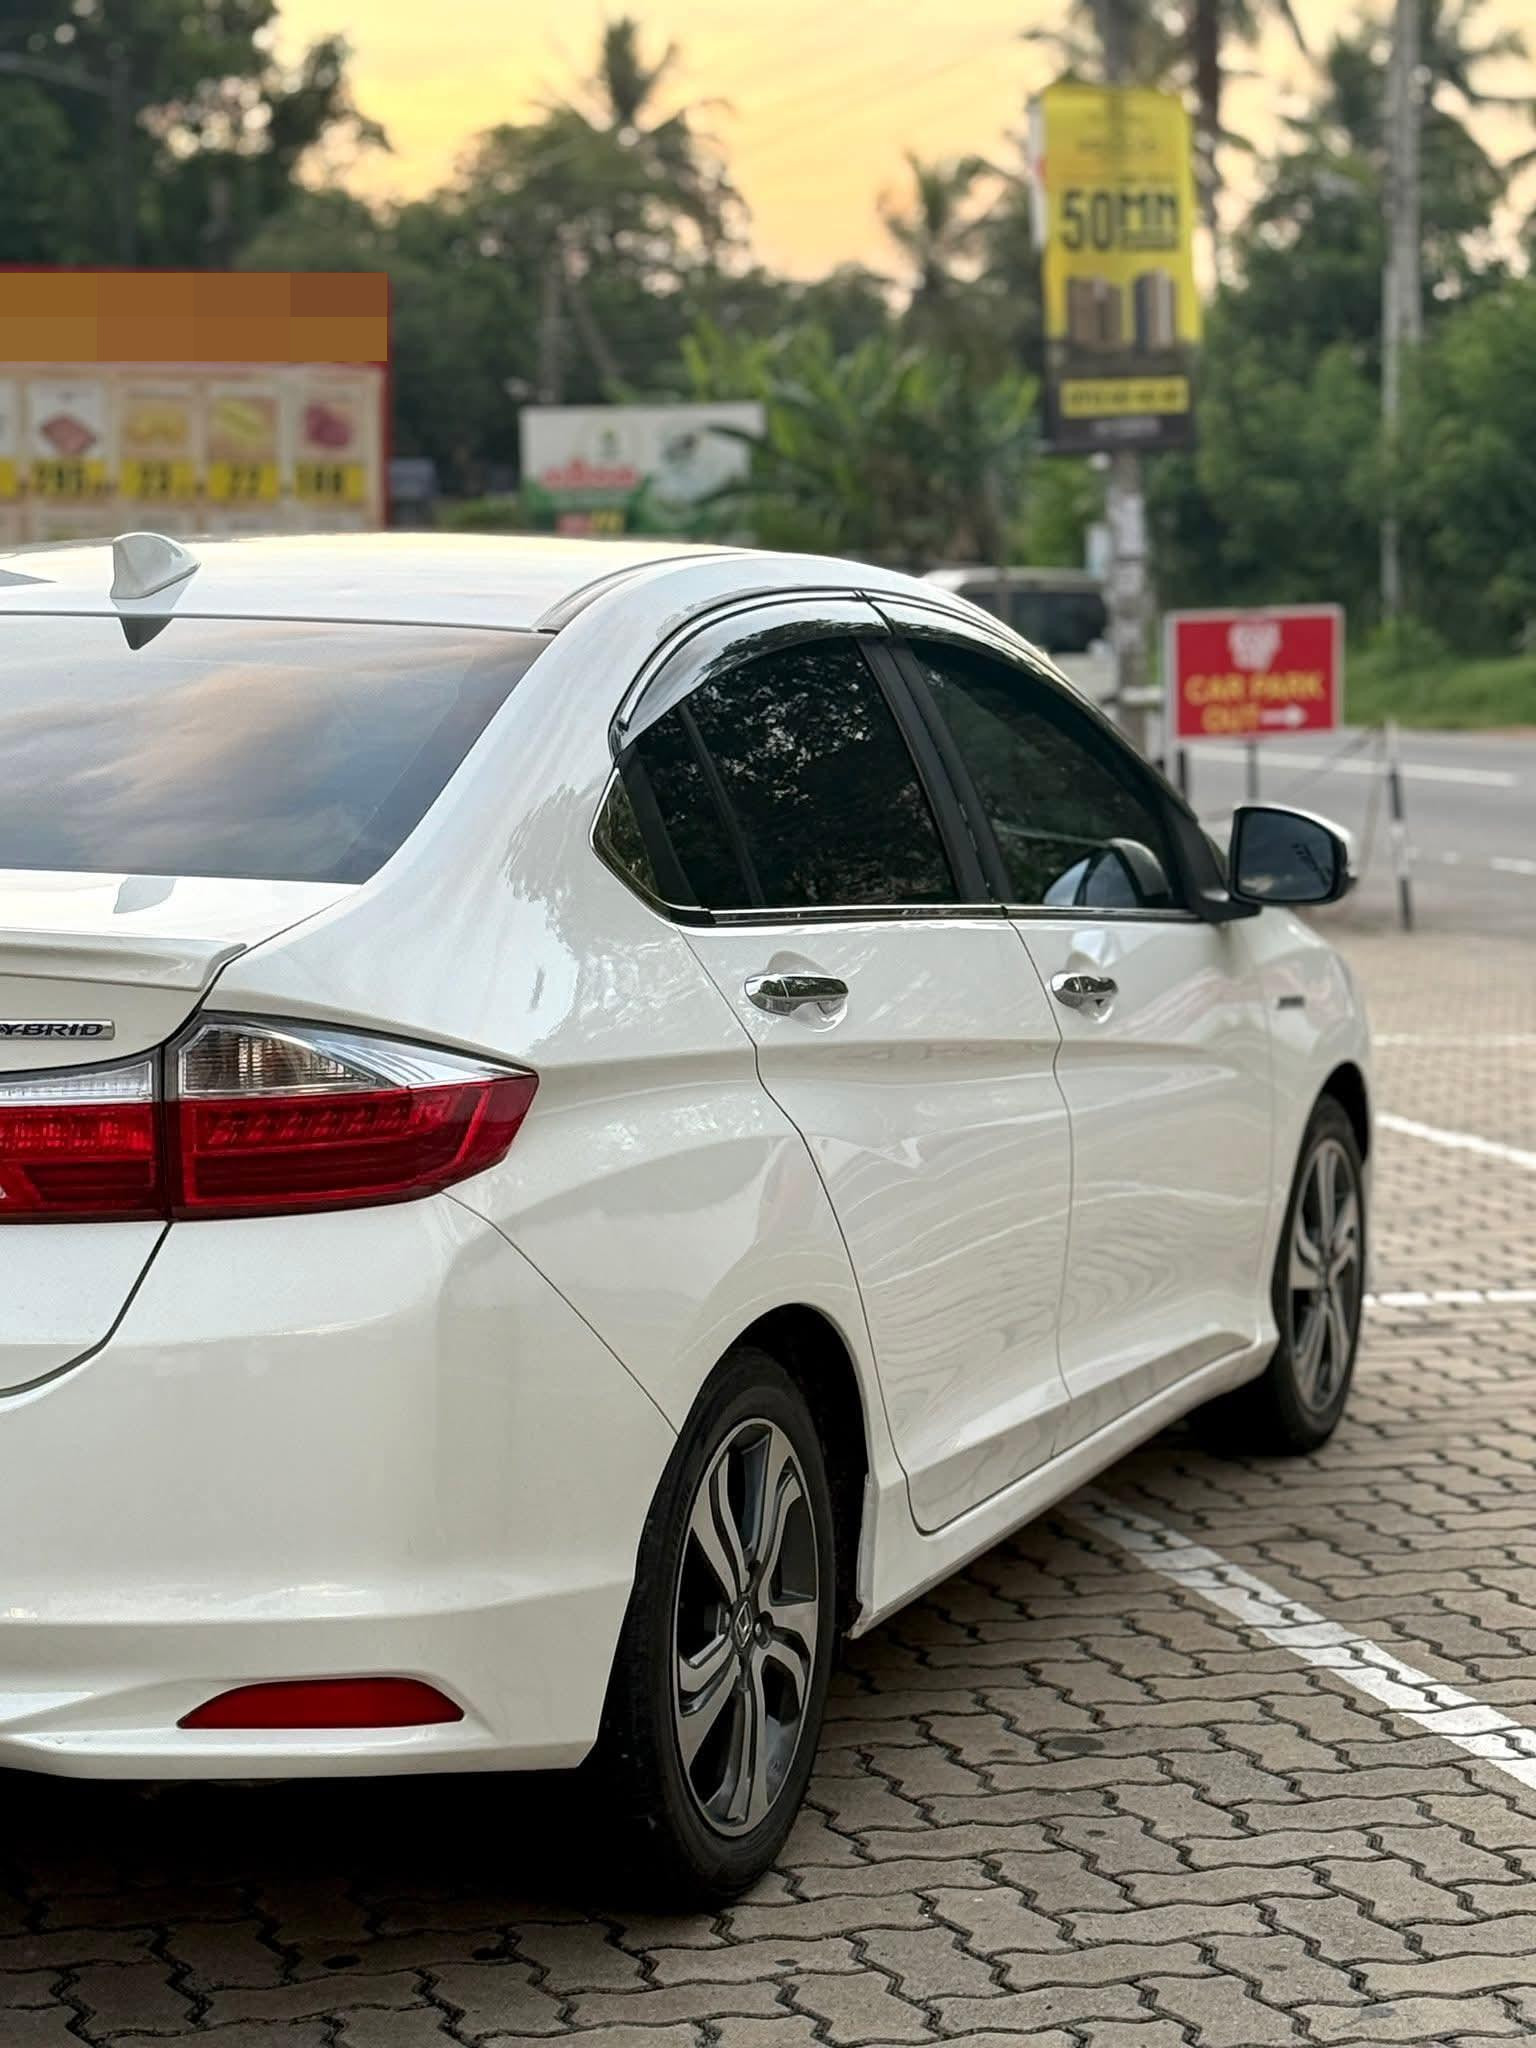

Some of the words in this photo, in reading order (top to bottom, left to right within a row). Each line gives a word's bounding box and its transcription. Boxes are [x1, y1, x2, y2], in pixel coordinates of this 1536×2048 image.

[1184, 673, 1245, 705] CAR
[1250, 669, 1326, 701] PARK
[1201, 703, 1260, 734] OUT
[0, 1023, 104, 1036] YBRID
